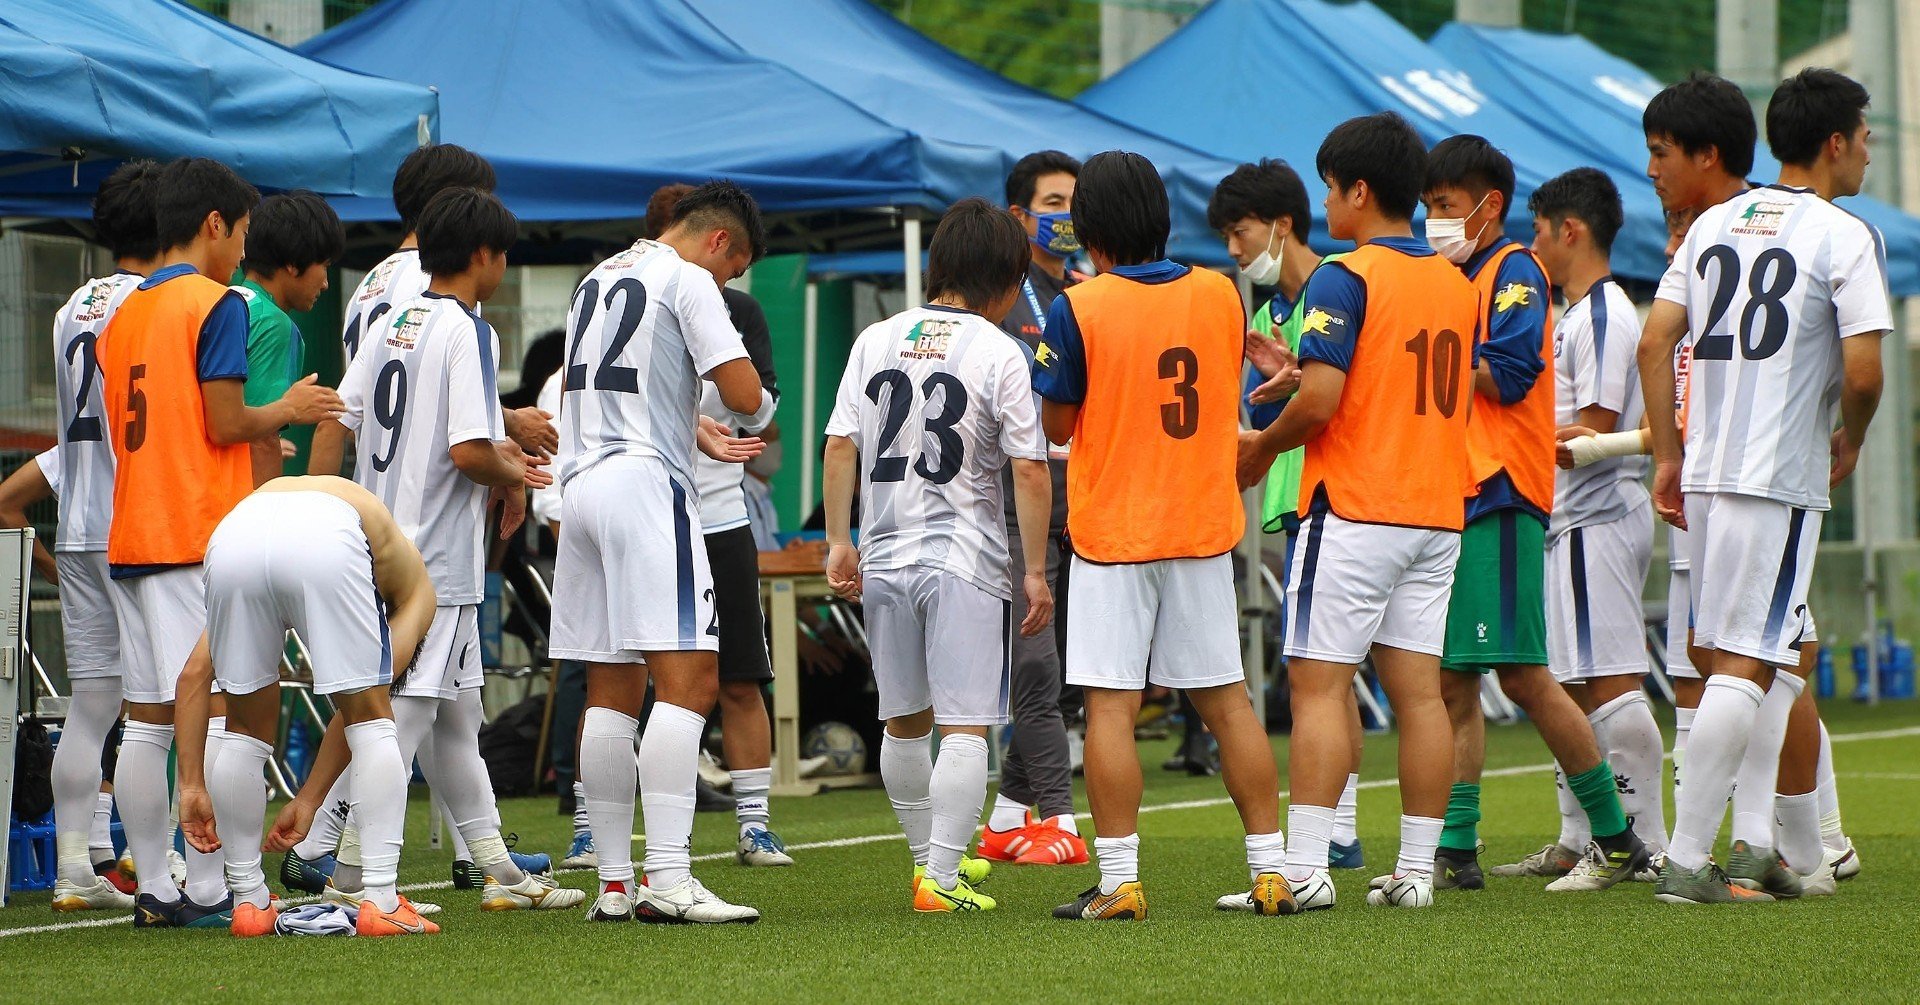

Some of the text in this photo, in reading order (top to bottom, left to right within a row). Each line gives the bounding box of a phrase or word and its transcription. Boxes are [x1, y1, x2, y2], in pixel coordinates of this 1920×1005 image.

[1052, 222, 1074, 235] GUN
[1730, 227, 1755, 235] FOREST
[343, 302, 392, 361] 1
[564, 277, 647, 394] 22
[1021, 324, 1042, 335] KEL
[1692, 244, 1797, 361] 28
[65, 331, 103, 442] 2
[124, 363, 147, 453] 5
[371, 358, 408, 473] 9
[1157, 347, 1199, 440] 3
[1405, 328, 1462, 419] 10
[864, 368, 968, 484] 23
[1788, 604, 1806, 651] 2
